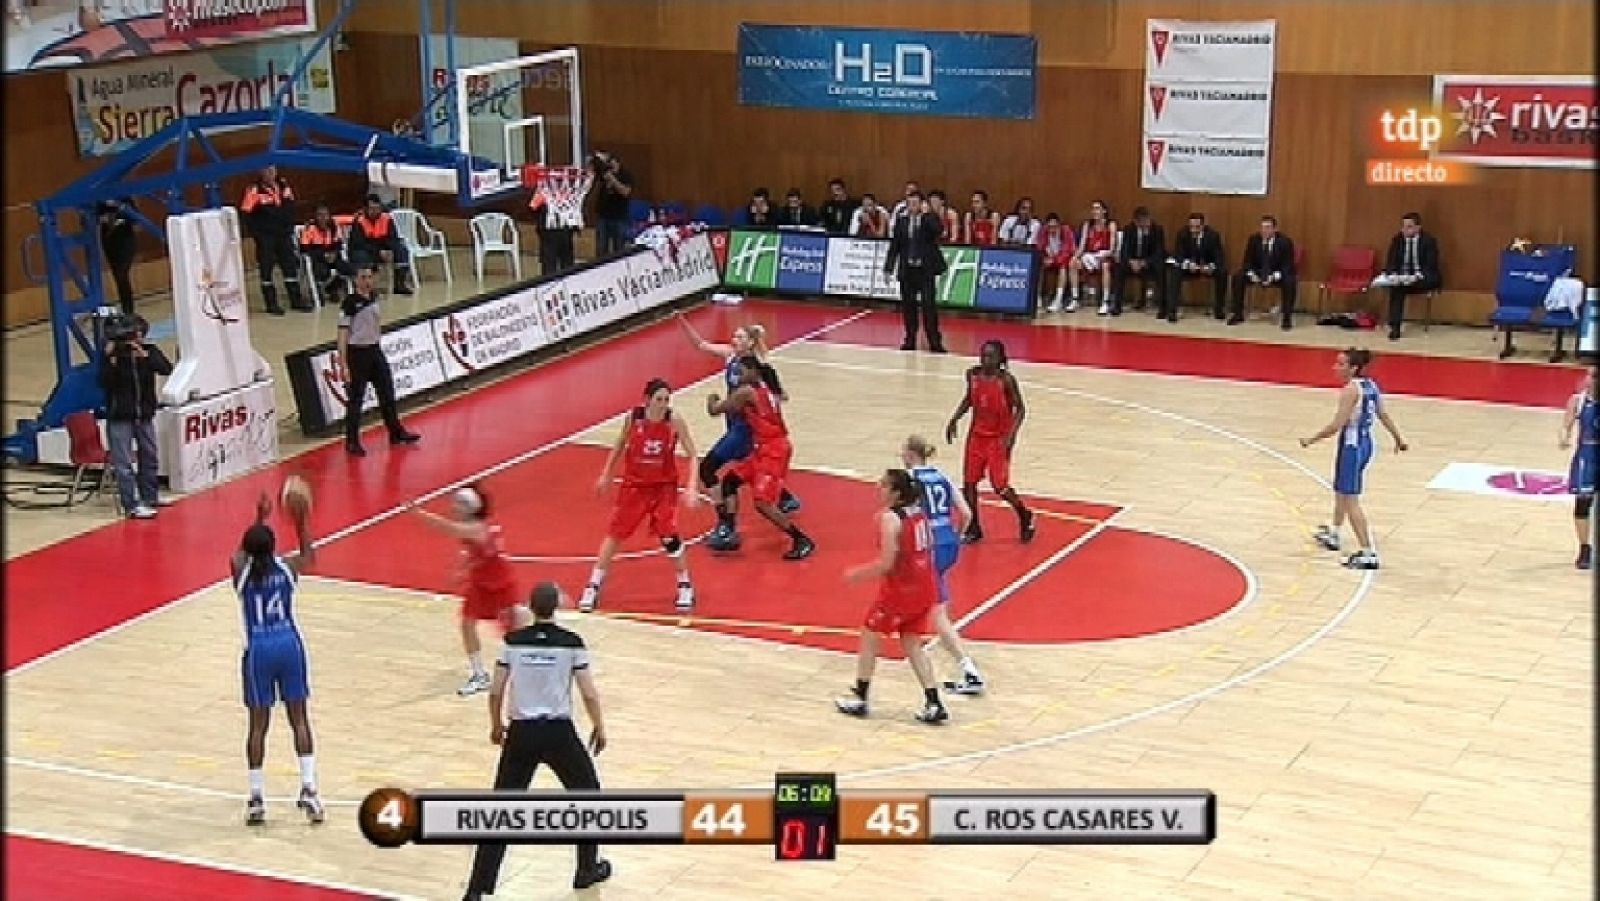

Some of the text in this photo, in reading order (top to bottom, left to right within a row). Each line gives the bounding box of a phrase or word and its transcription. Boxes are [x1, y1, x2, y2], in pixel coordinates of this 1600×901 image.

[100, 103, 175, 145] Sierra
[571, 288, 617, 317] Rivas
[184, 406, 248, 444] Rivas
[642, 440, 663, 454] 25
[925, 484, 951, 514] 12
[254, 590, 285, 625] 14
